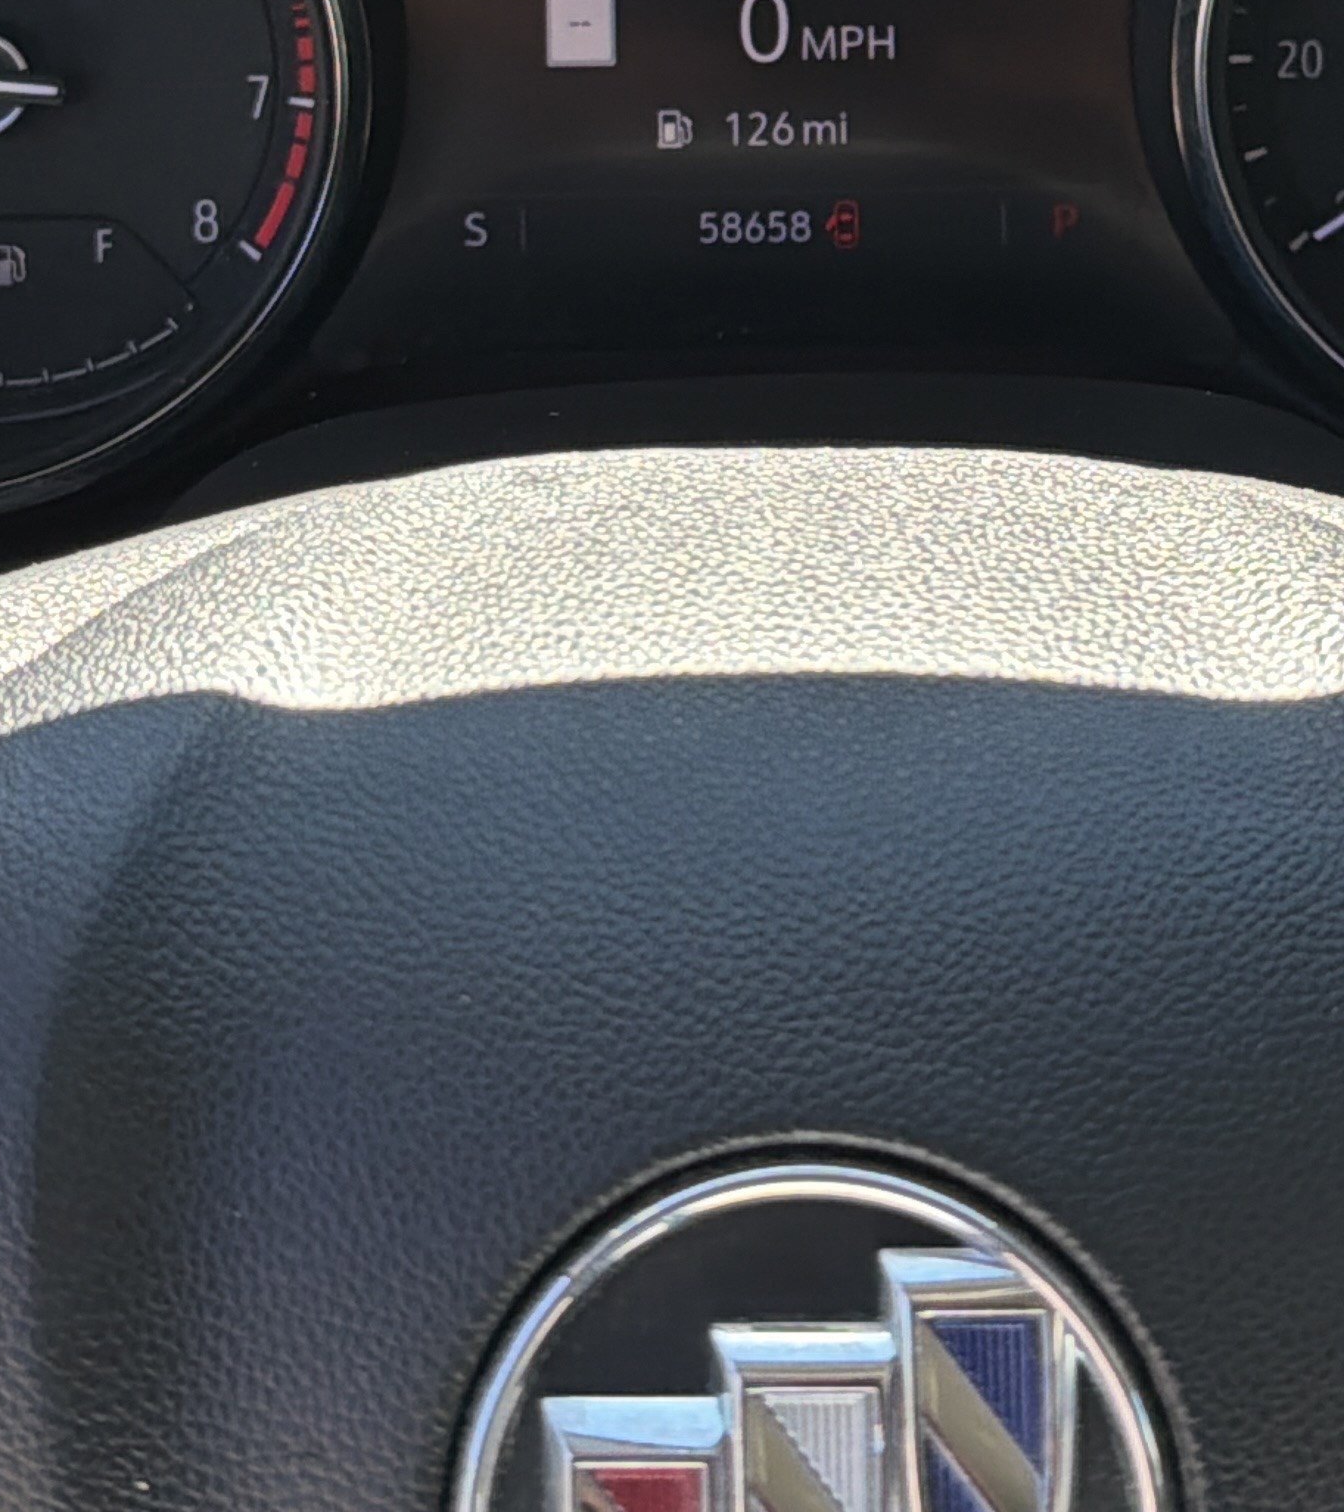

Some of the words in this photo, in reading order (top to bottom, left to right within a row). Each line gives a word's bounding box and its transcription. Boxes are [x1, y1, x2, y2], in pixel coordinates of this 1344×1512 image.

[801, 26, 896, 61] MPH
[1276, 39, 1324, 81] 20
[246, 75, 269, 119] 7
[725, 112, 795, 147] 126
[802, 110, 849, 146] mi
[194, 200, 219, 243] 8
[464, 213, 489, 247] S
[698, 211, 813, 244] 58658
[1055, 205, 1080, 235] P
[95, 229, 113, 262] F
